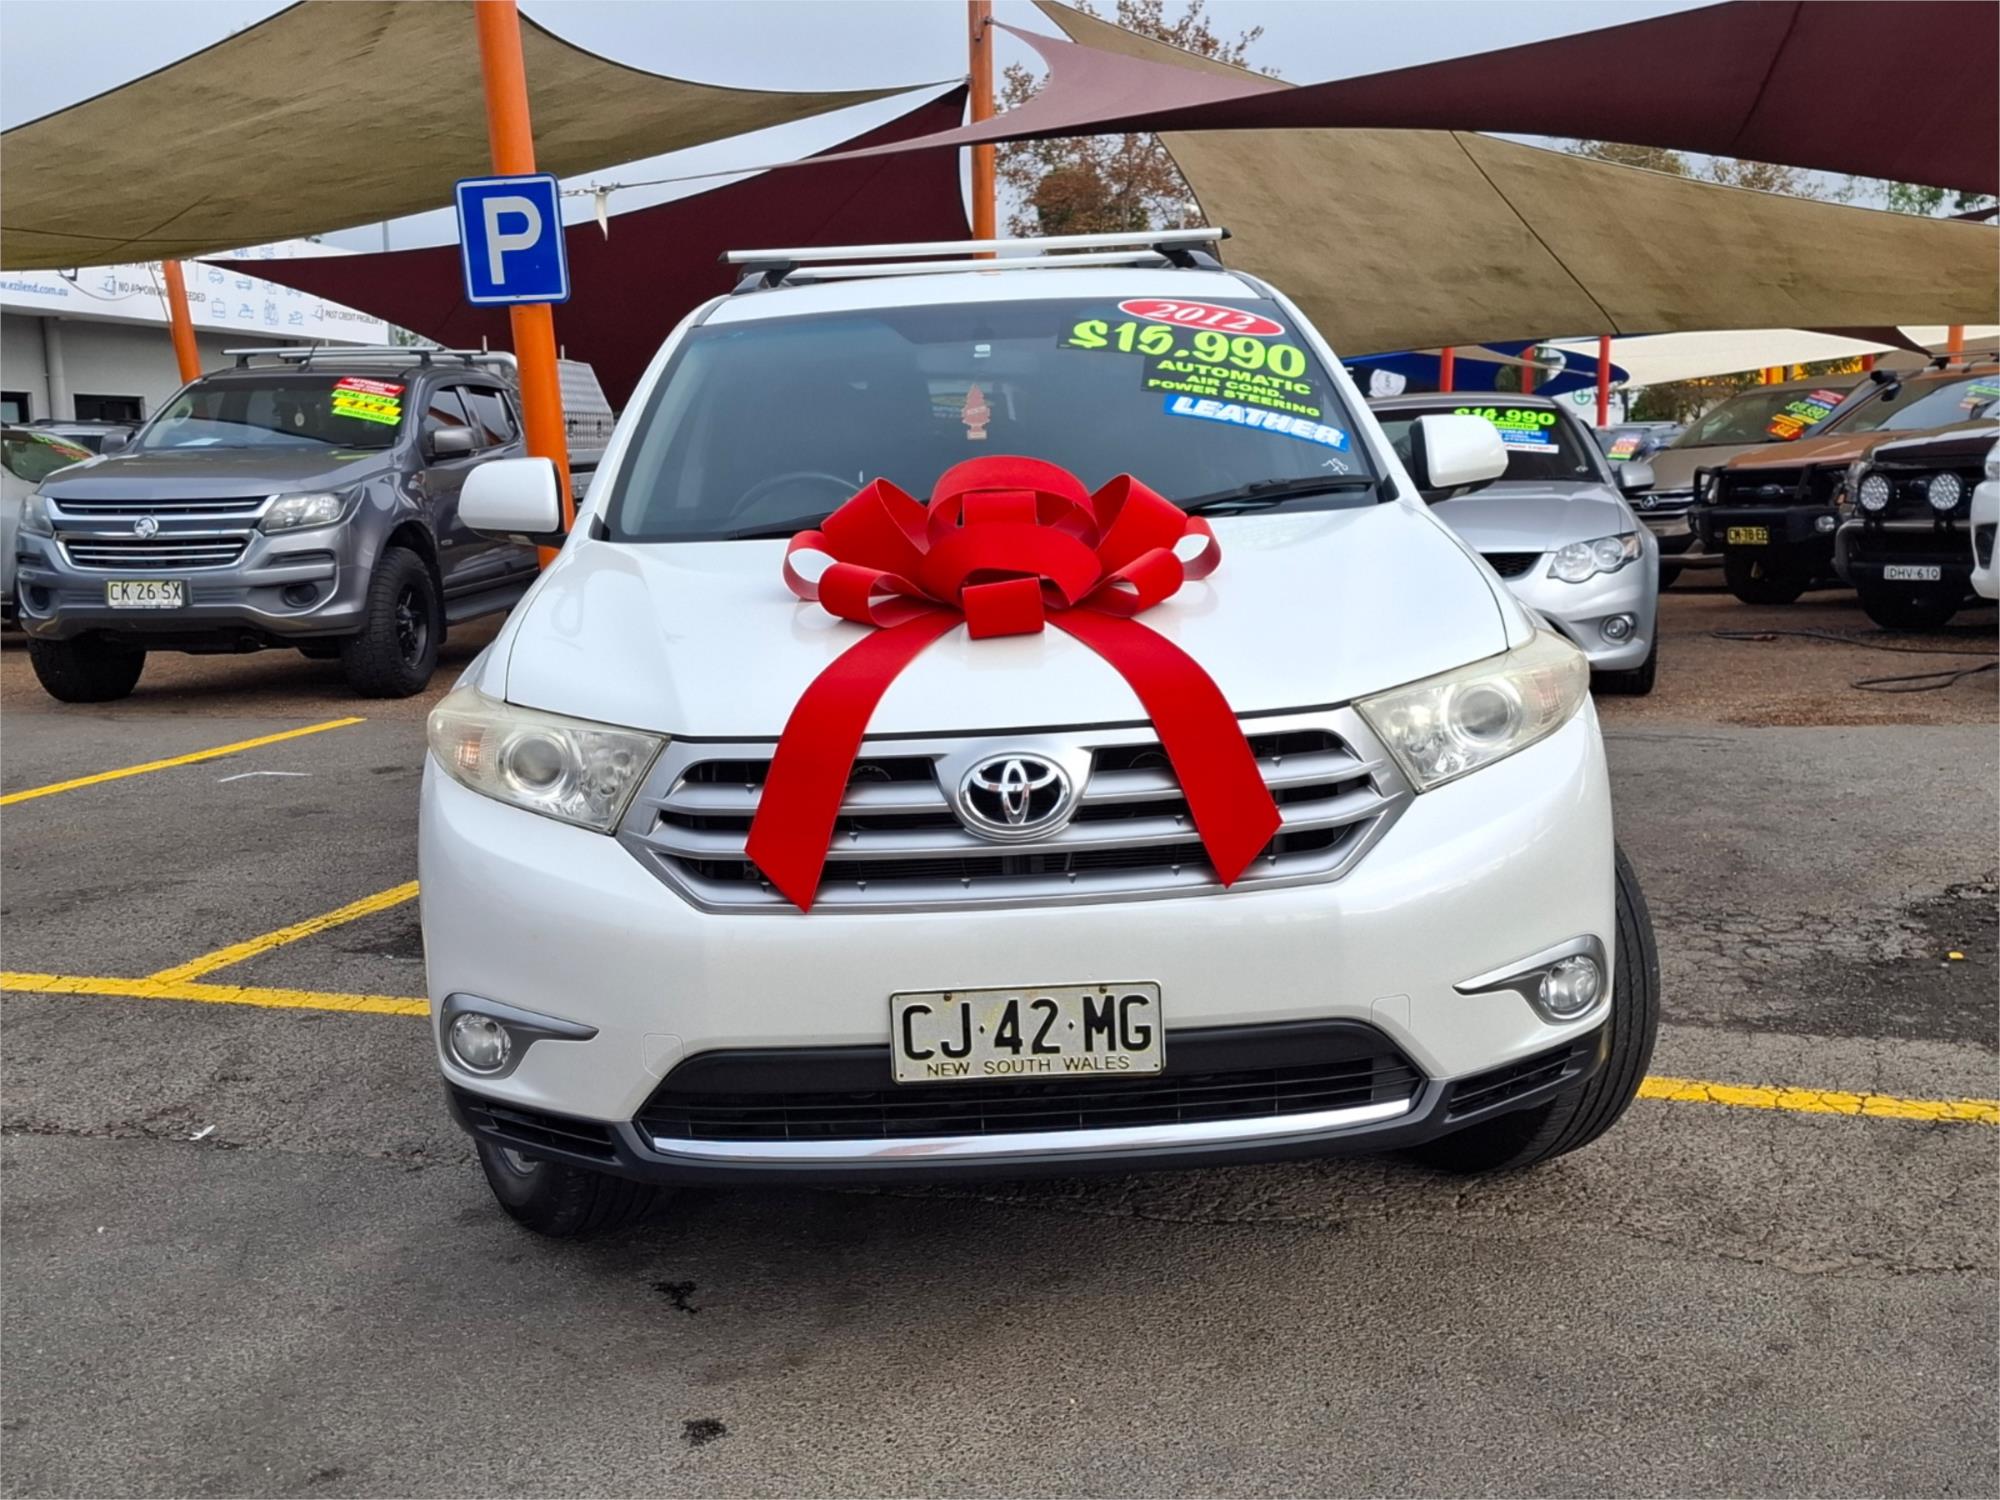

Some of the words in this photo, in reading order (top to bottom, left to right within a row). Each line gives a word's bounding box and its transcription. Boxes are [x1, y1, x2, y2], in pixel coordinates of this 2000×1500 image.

[482, 196, 542, 285] P
[118, 282, 129, 293] NO
[186, 290, 206, 302] EEDED
[1142, 303, 1256, 331] 2012
[1157, 360, 1311, 395] AUTOMATIC
[1186, 375, 1221, 387] AIR
[1225, 380, 1286, 399] COND.
[1148, 379, 1219, 396] POWER
[1223, 389, 1321, 417] STEERING
[1171, 395, 1346, 448] LEATHER
[110, 582, 130, 600] CK
[926, 1061, 971, 1077] NEW
[983, 1059, 1051, 1075] SOUTH
[1063, 1055, 1131, 1072] WALES
